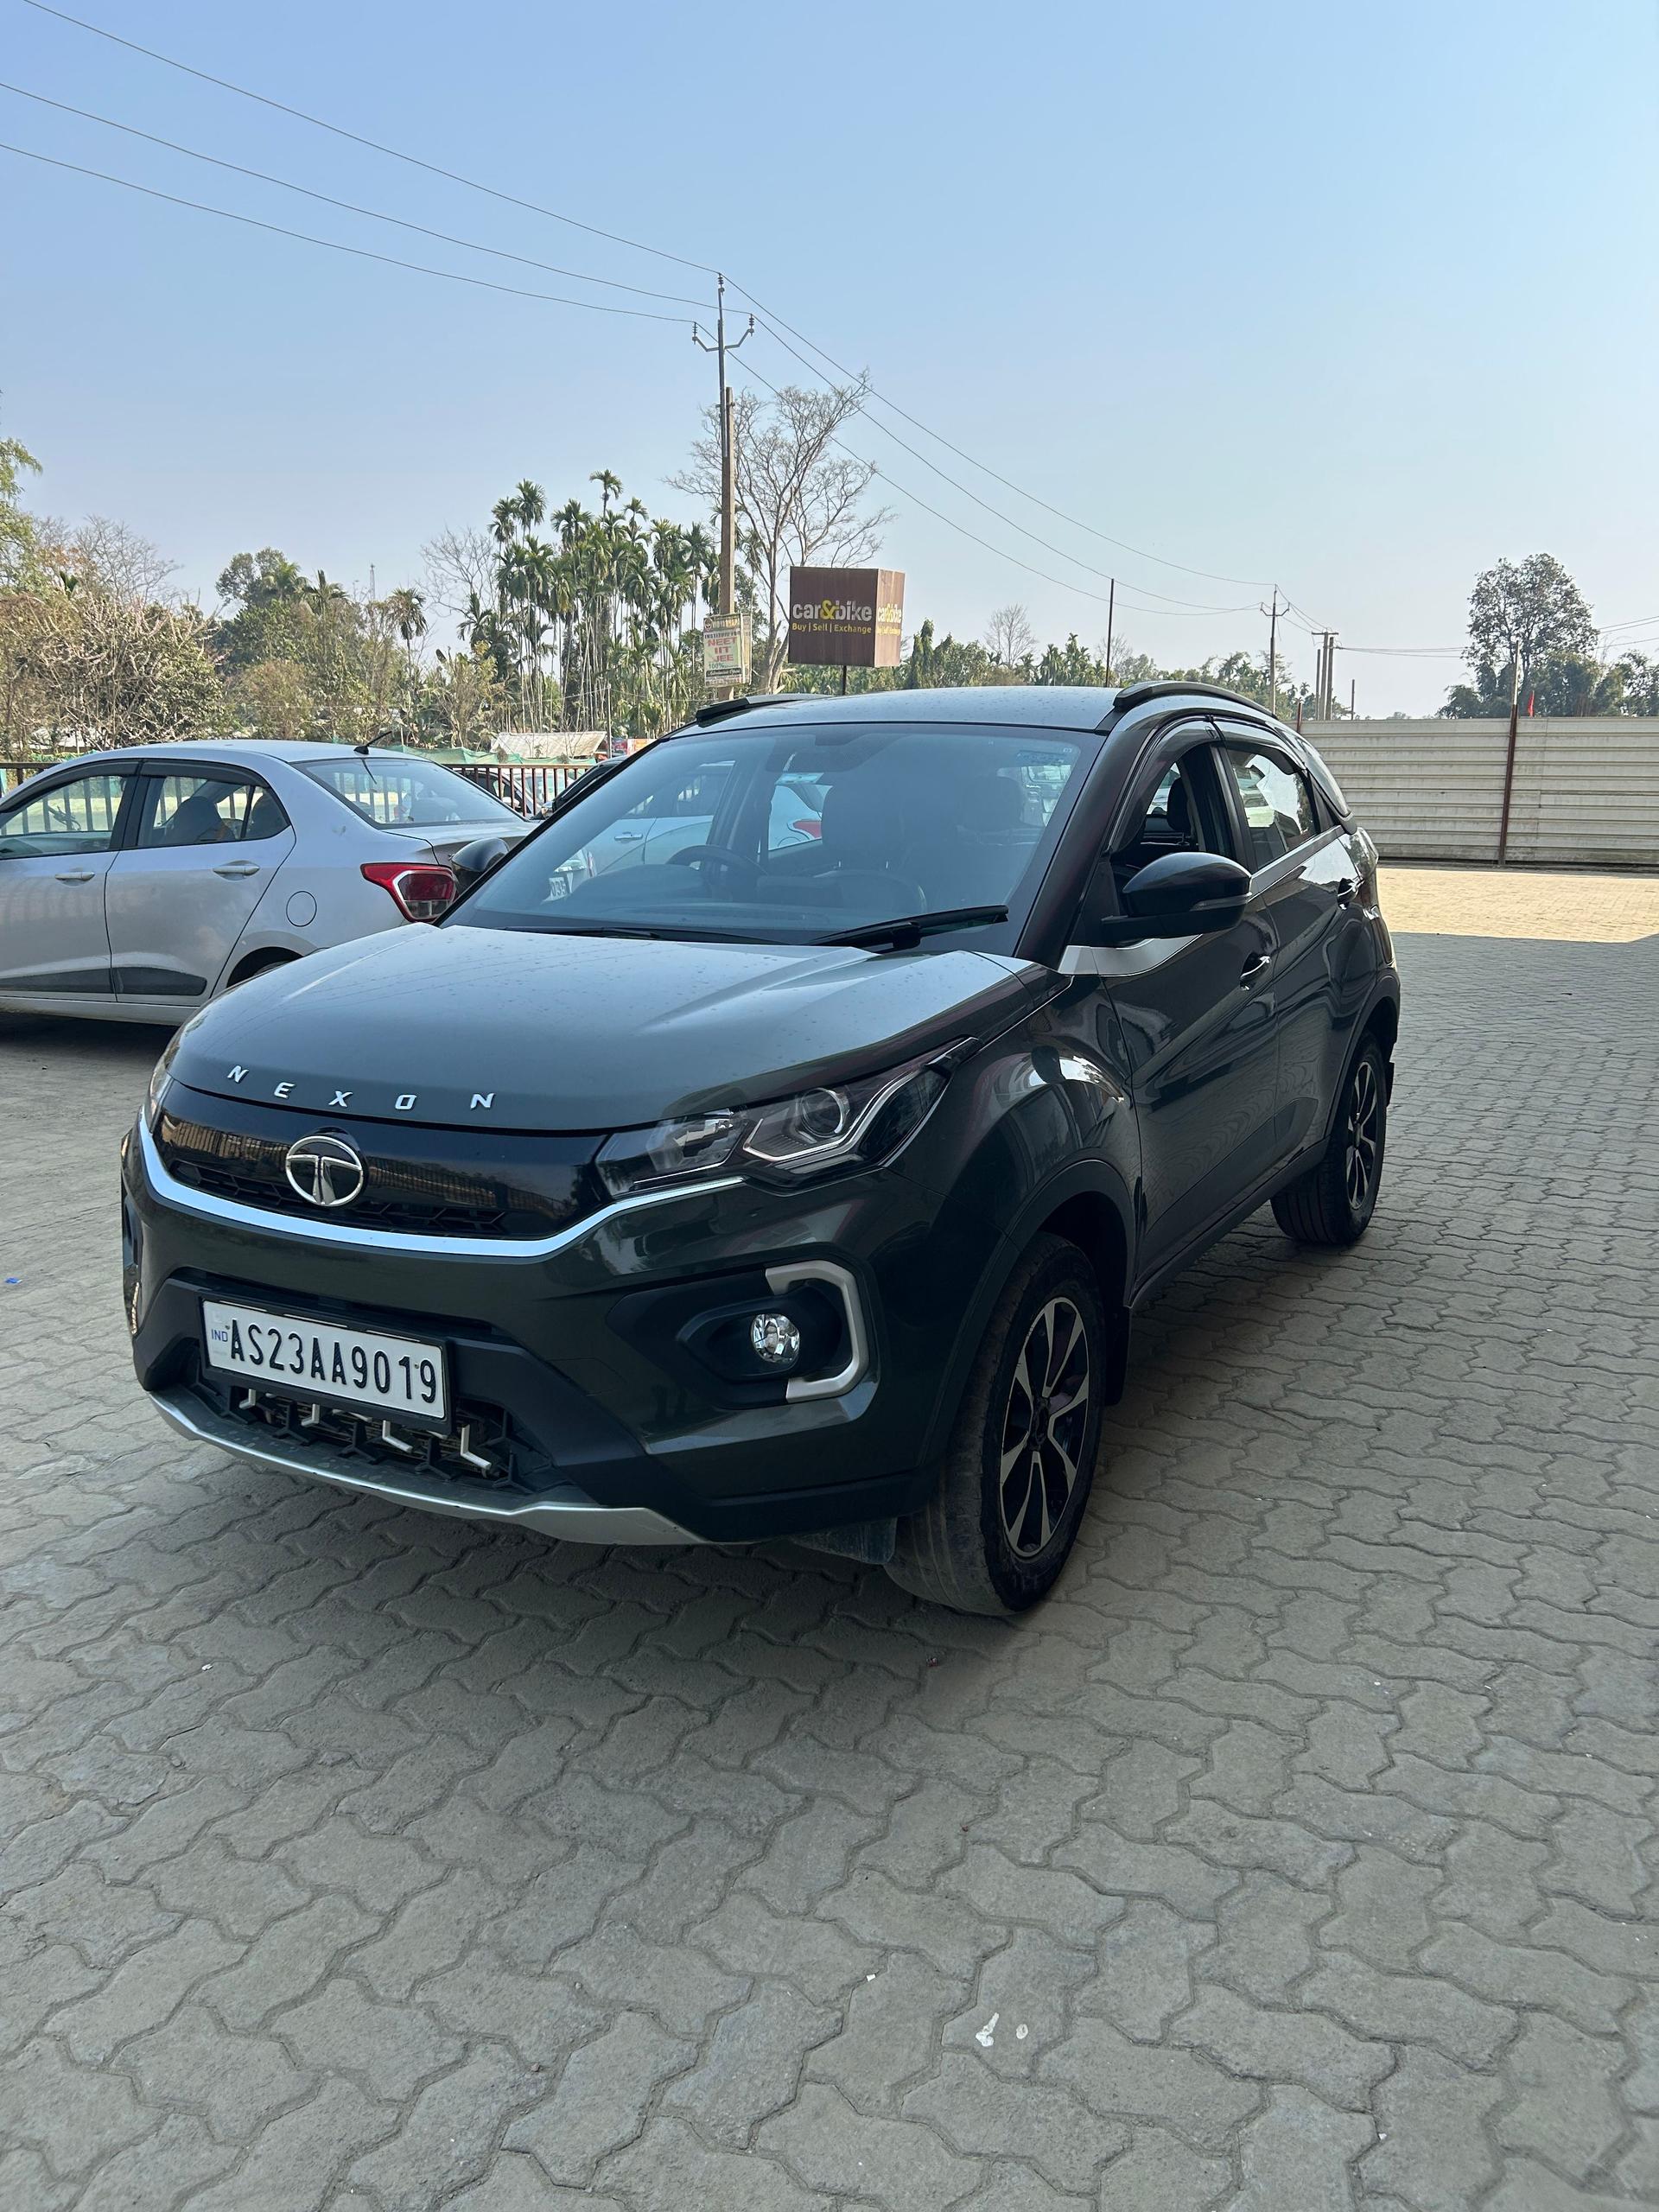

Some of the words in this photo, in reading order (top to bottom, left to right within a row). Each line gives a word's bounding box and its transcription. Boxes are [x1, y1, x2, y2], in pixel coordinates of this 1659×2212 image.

[792, 600, 873, 621] car&bike
[791, 622, 807, 632] Buy
[812, 623, 828, 632] Sell
[834, 624, 872, 634] Exchange
[708, 637, 737, 646] NEET
[226, 1065, 495, 1110] NEXON
[211, 1328, 228, 1343] IND
[230, 1319, 437, 1404] AS23AA9019
